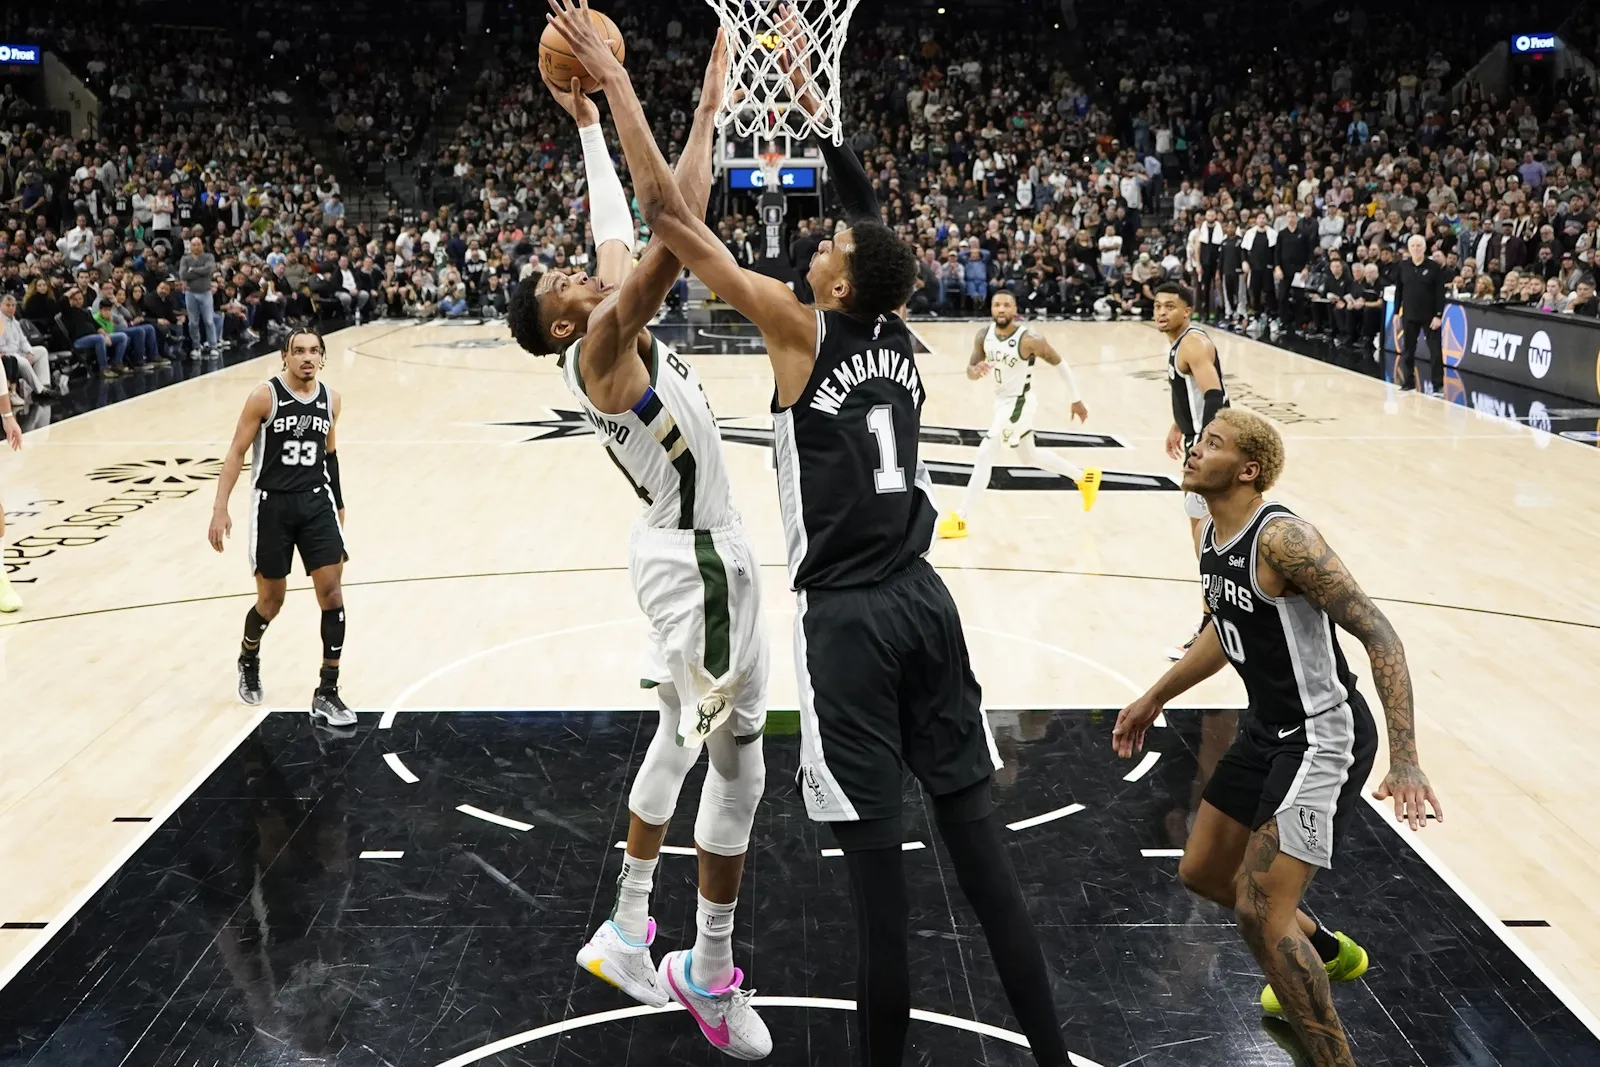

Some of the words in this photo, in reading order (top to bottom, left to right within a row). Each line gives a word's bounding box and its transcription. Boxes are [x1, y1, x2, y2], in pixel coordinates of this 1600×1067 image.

[11, 48, 35, 60] Frost
[1531, 36, 1554, 48] Frost
[1471, 328, 1523, 362] NEXT
[273, 415, 331, 438] SPURS
[281, 440, 318, 467] 33
[866, 404, 907, 494] 1
[43, 488, 199, 530] Frost
[1203, 574, 1254, 613] PURS
